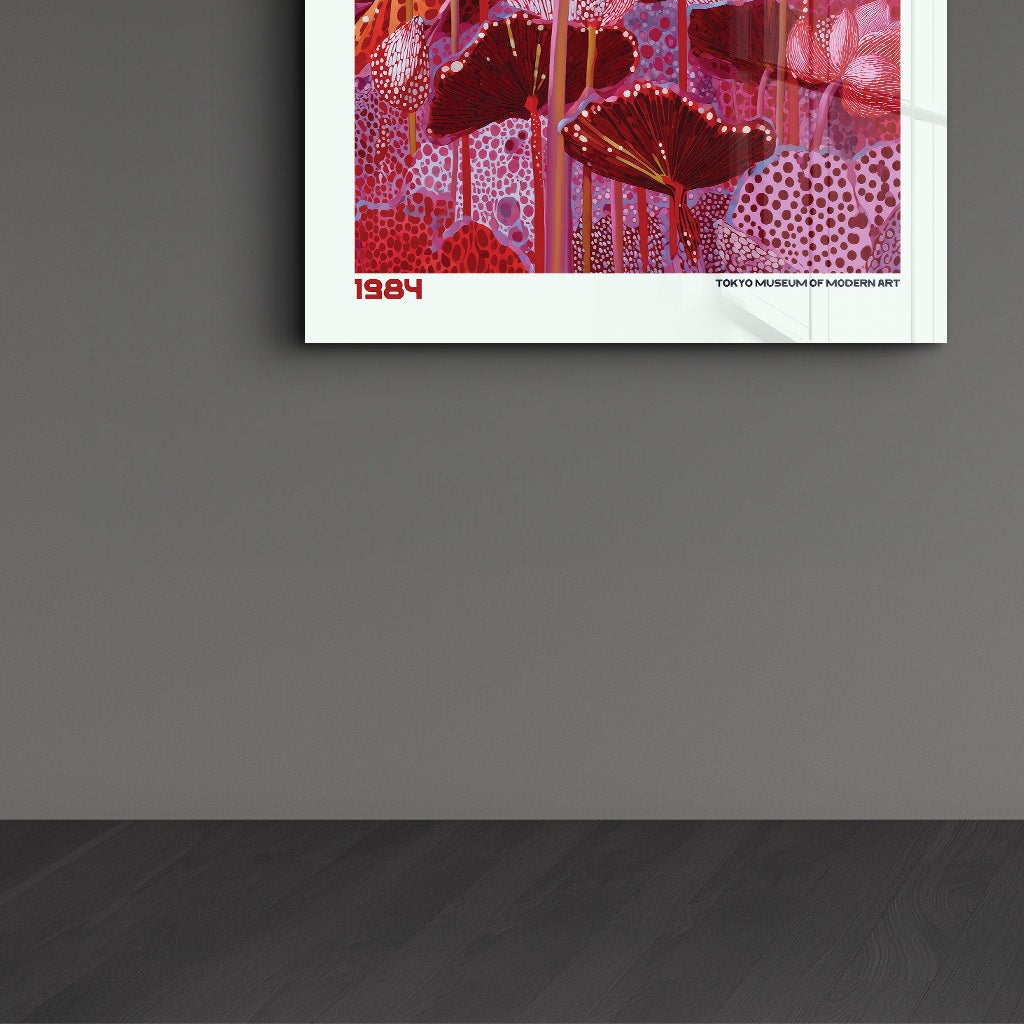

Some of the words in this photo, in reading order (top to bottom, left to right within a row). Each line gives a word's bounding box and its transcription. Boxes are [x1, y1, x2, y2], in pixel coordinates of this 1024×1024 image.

[354, 278, 423, 300] 1984
[715, 278, 753, 288] TOKYO
[755, 278, 808, 288] MUSEUM
[809, 278, 824, 288] OF
[825, 278, 876, 288] MODERN
[877, 278, 901, 288] ART
